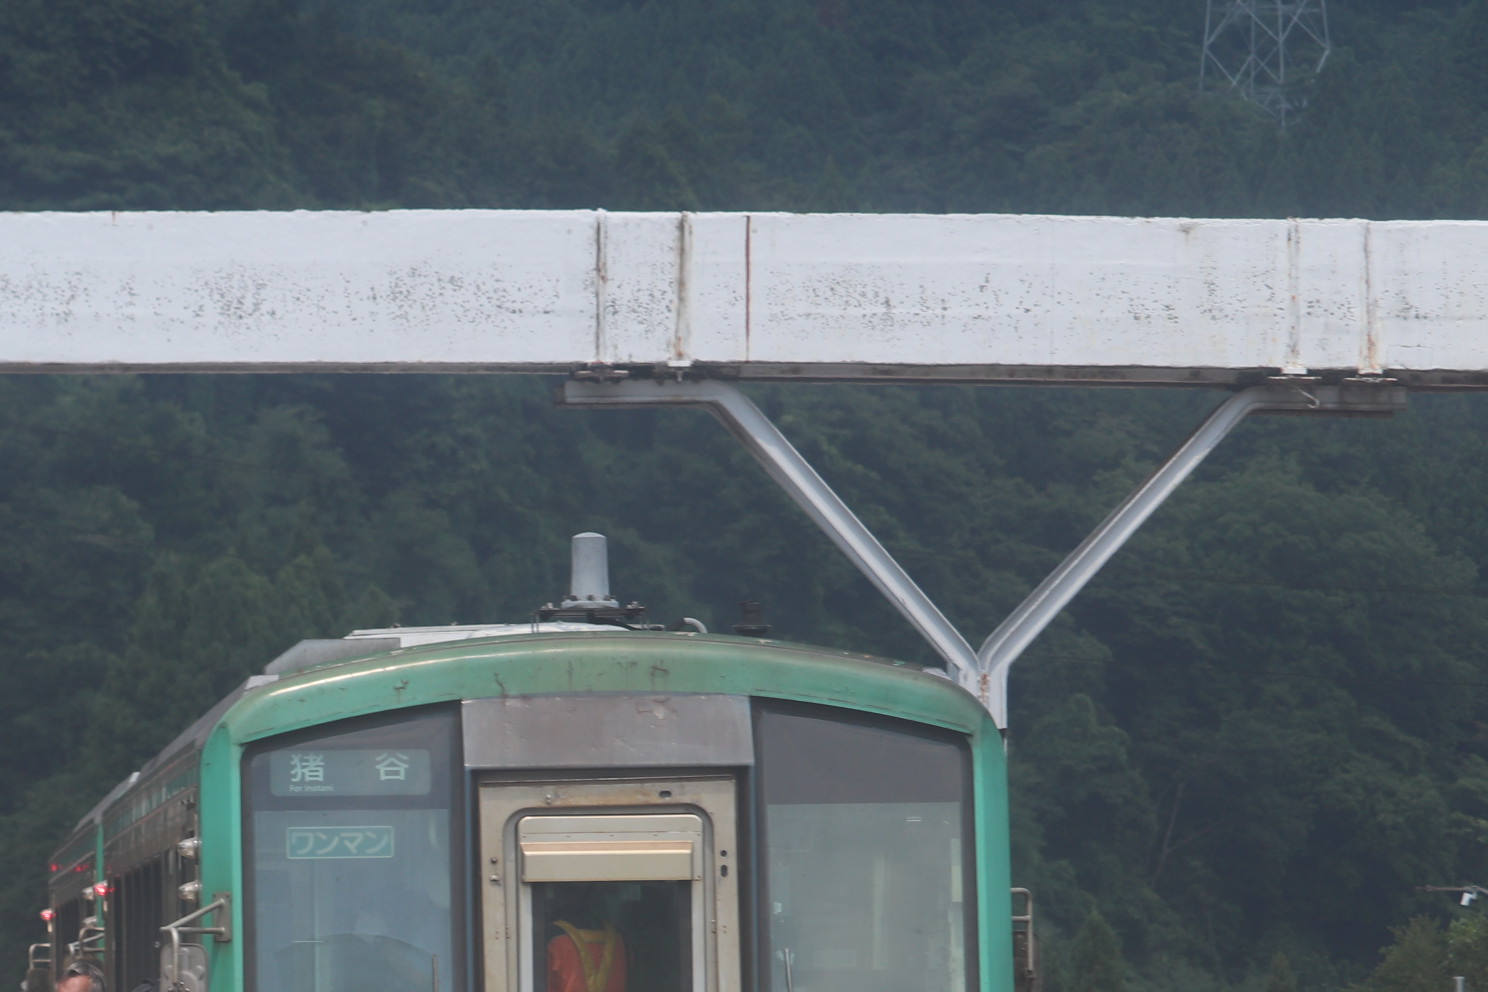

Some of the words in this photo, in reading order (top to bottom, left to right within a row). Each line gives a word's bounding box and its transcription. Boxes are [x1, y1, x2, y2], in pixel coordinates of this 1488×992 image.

[290, 753, 409, 782] 猪谷
[291, 831, 390, 855] ワンマン
